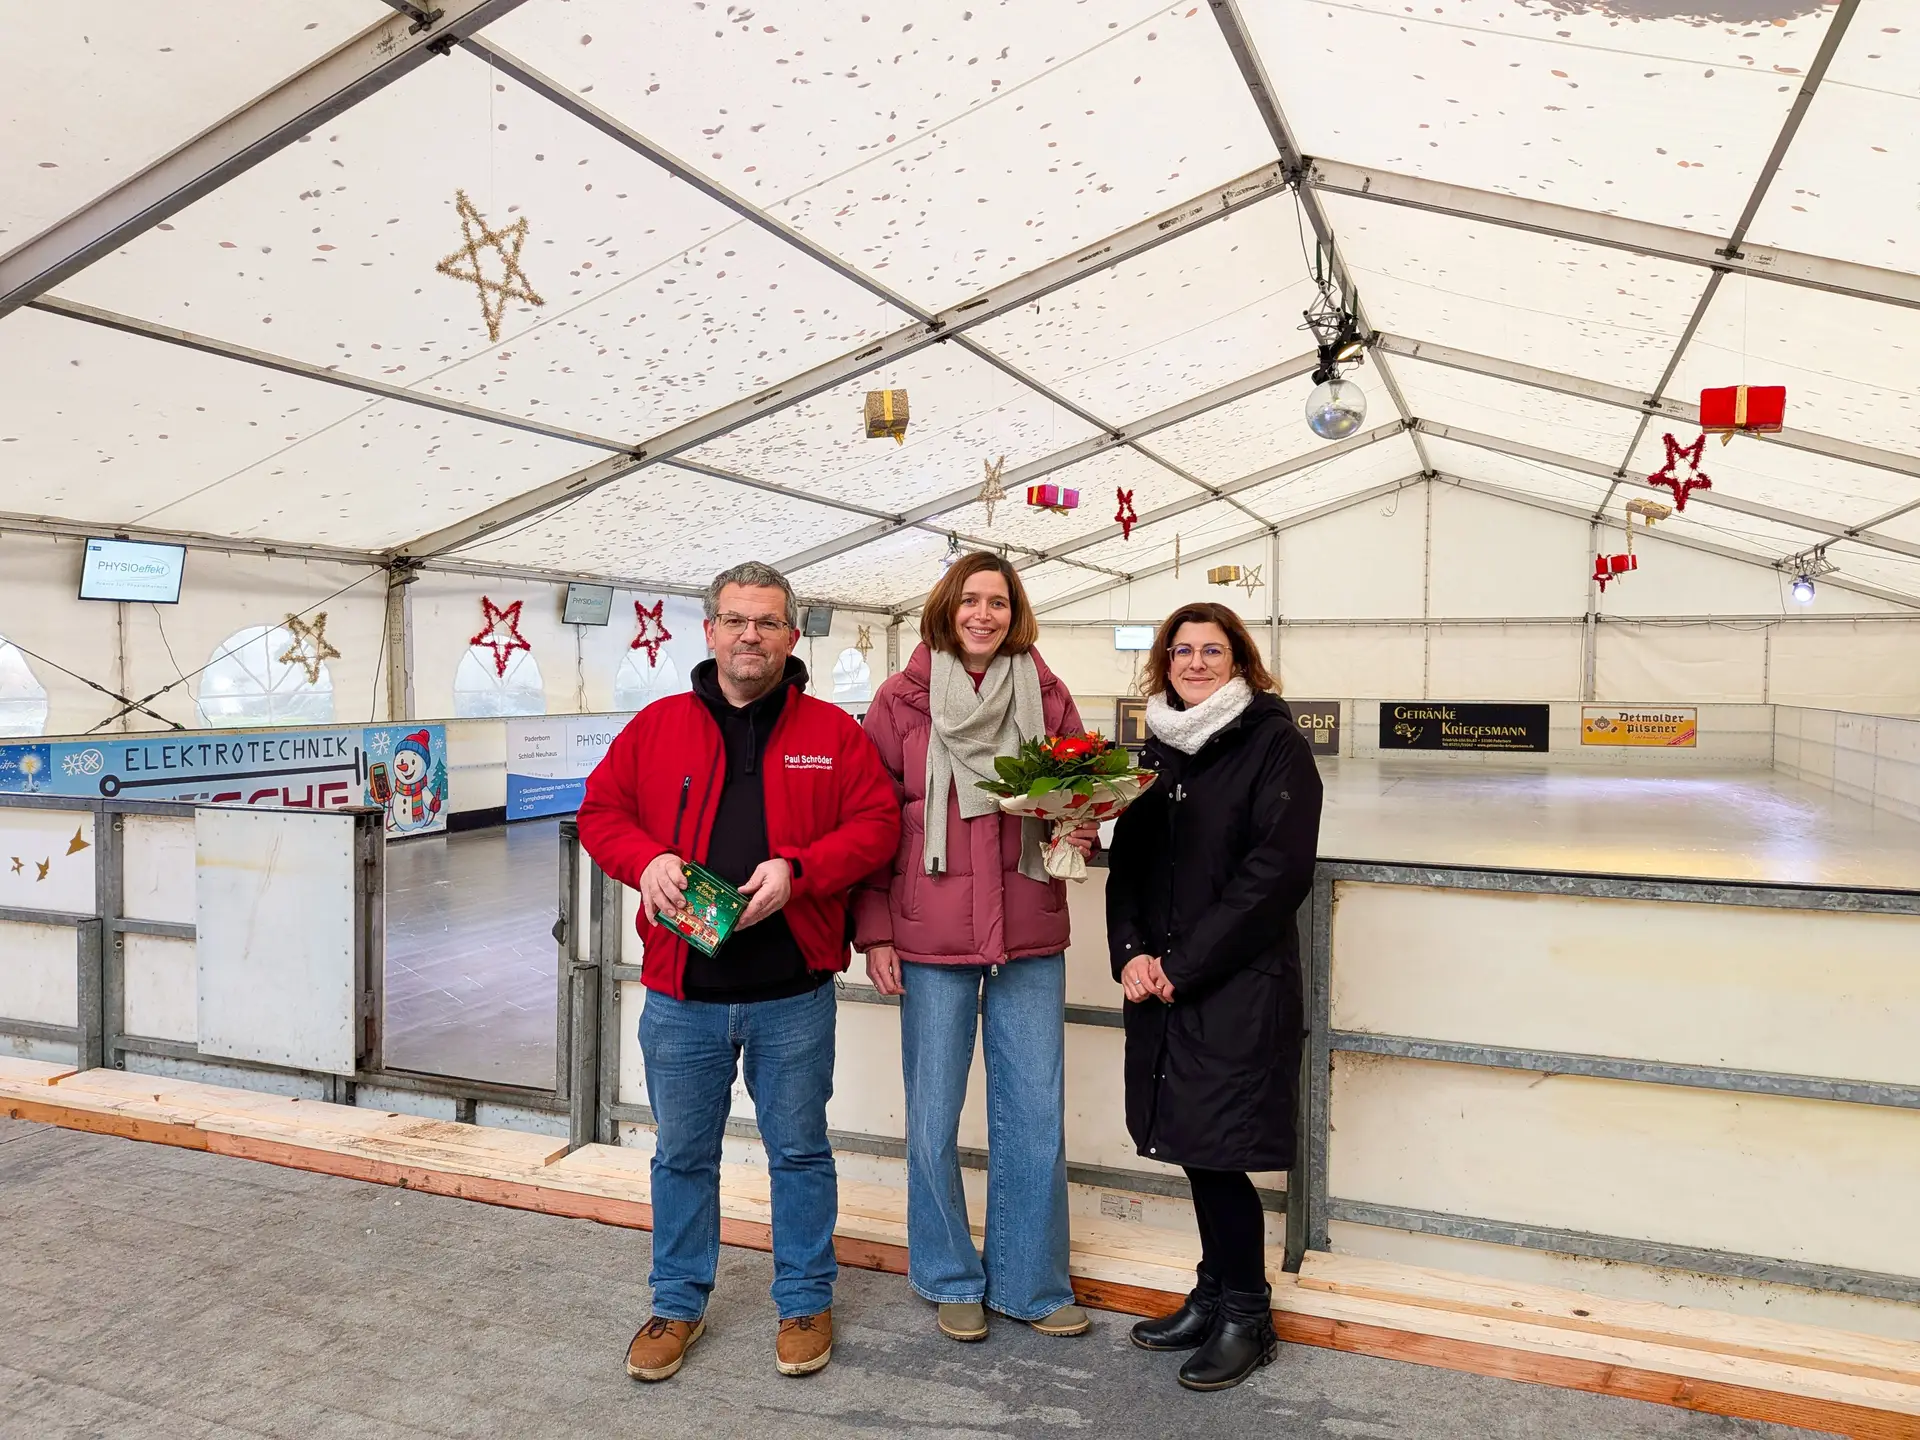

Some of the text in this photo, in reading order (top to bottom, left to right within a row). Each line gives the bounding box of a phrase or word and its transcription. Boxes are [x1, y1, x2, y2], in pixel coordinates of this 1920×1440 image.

[98, 561, 164, 574] PHYSIOeffekt
[1297, 714, 1335, 729] GbR
[1618, 712, 1685, 723] Detmolder
[1627, 724, 1677, 734] Pilsener
[125, 736, 348, 771] ELEKTROTECHNIK
[536, 751, 557, 759] Neuhaus
[784, 754, 833, 764] Paul Schröder
